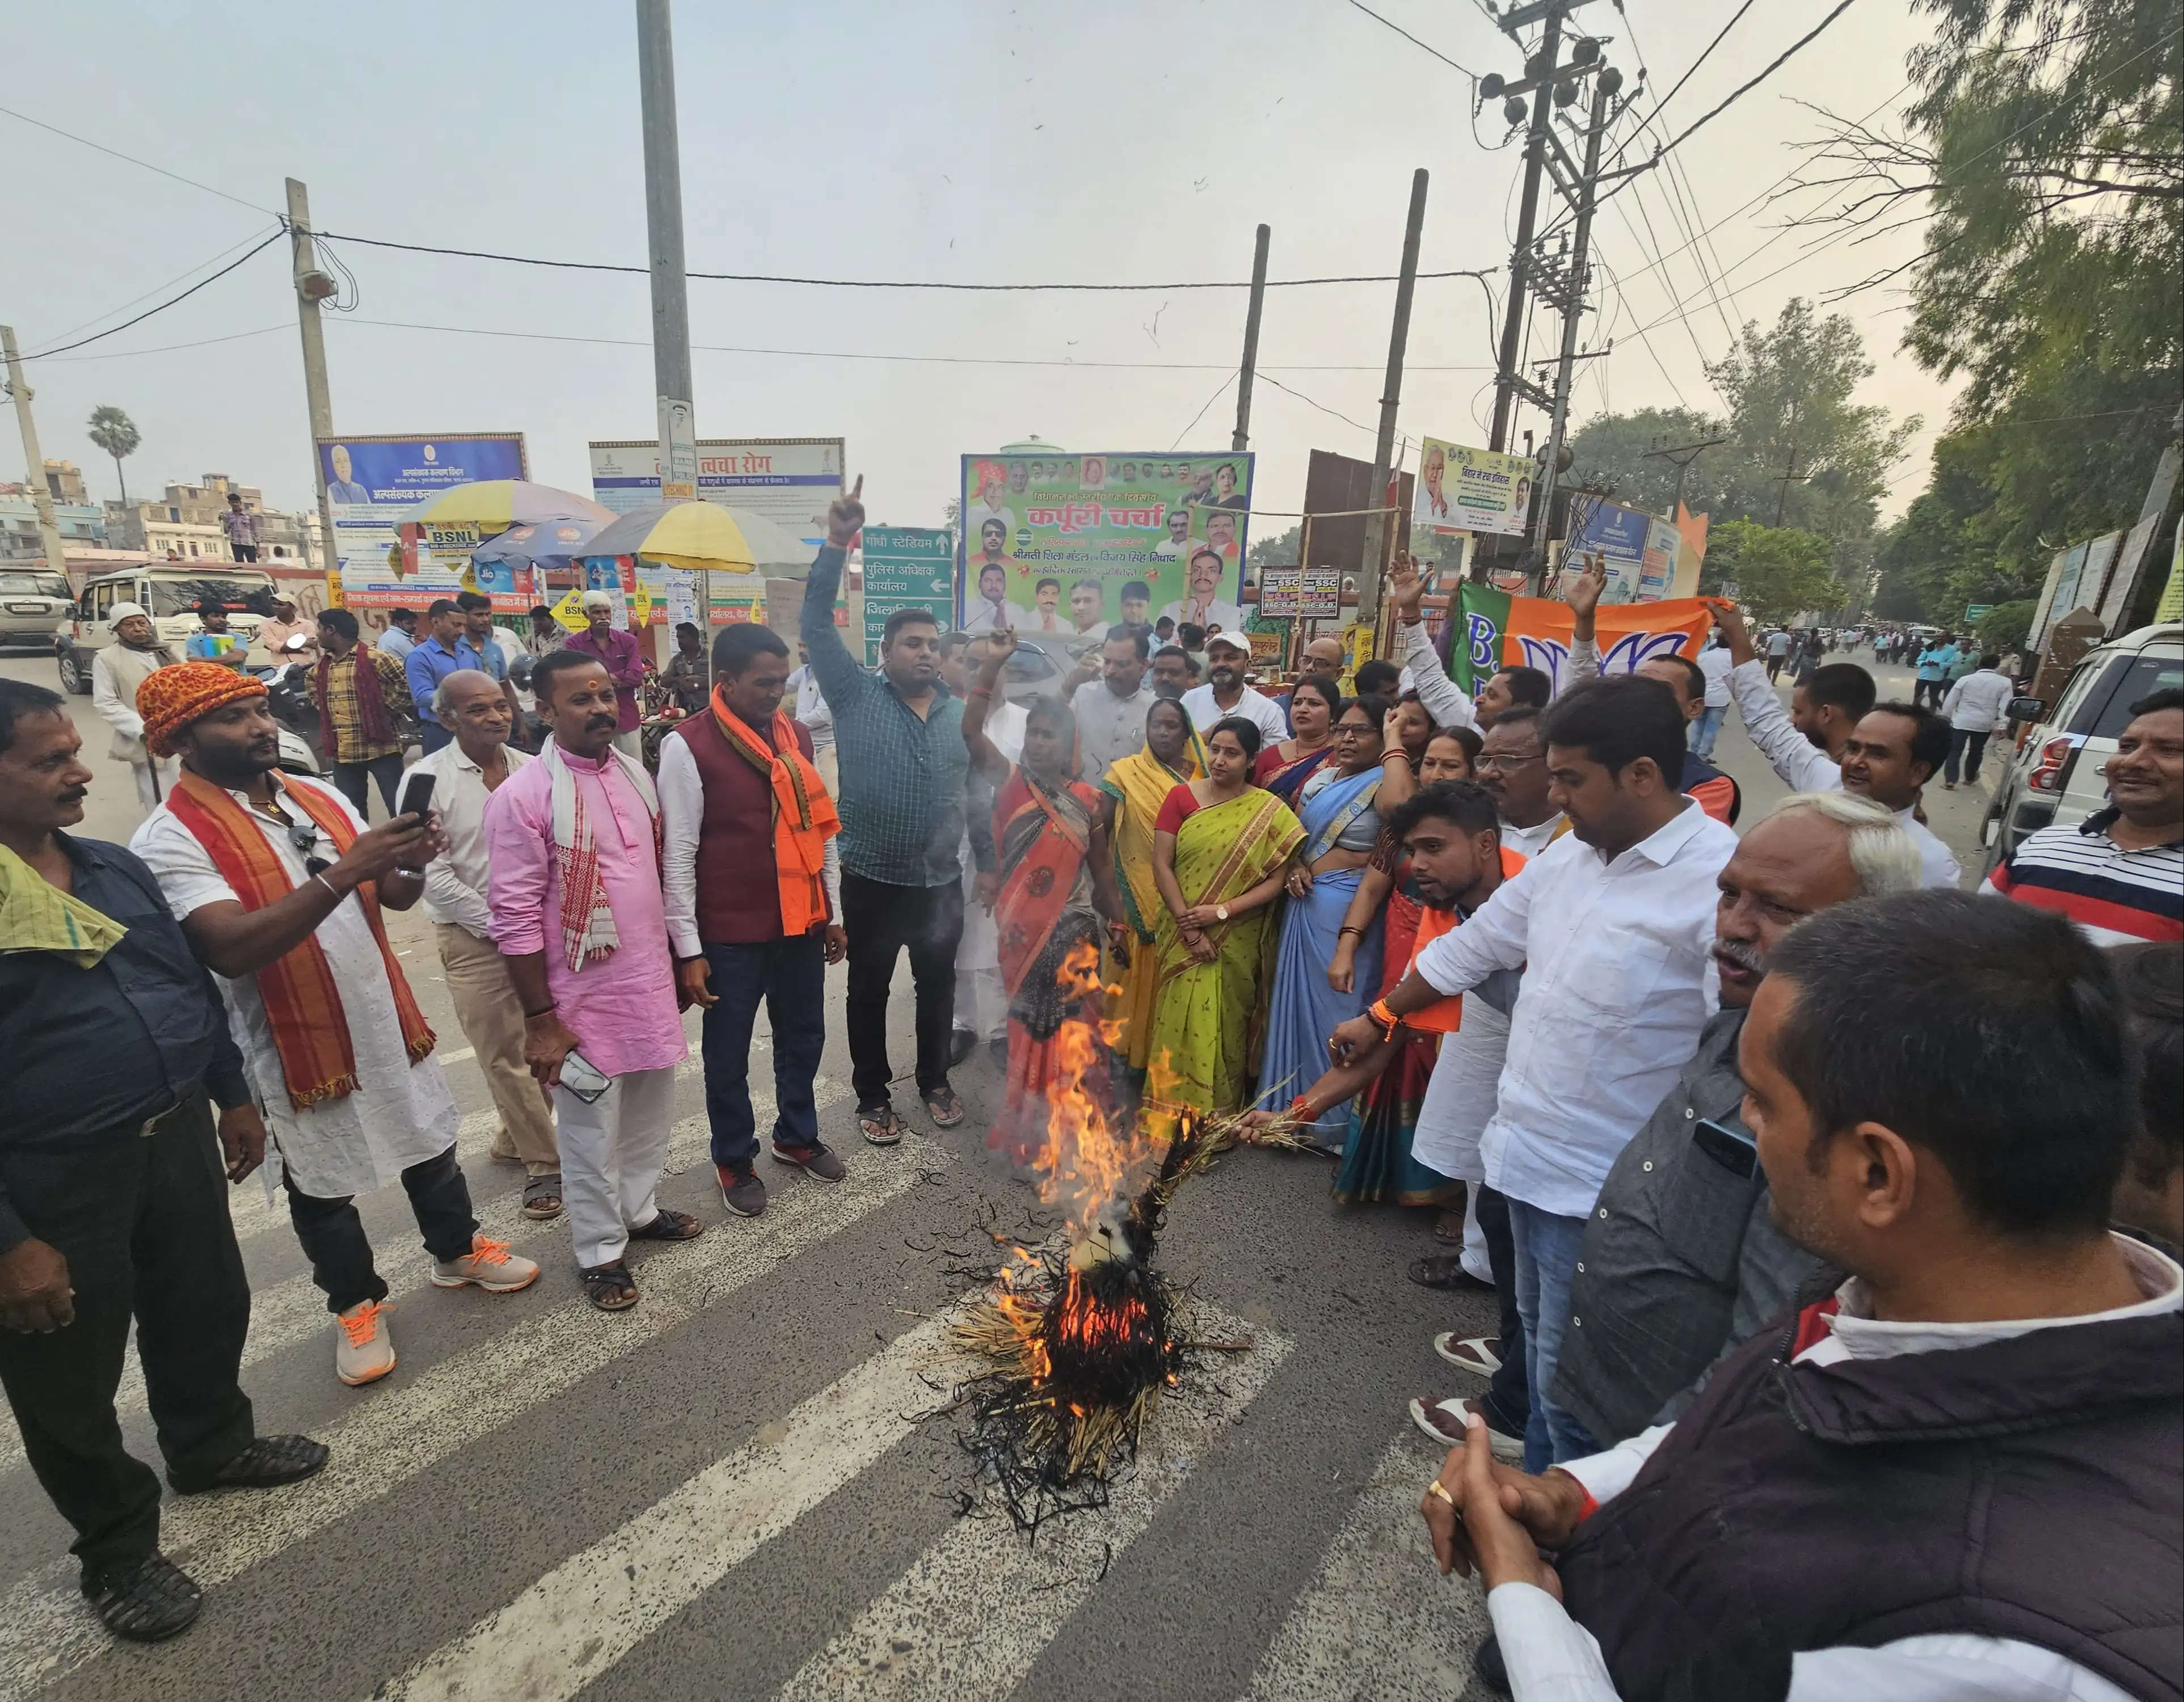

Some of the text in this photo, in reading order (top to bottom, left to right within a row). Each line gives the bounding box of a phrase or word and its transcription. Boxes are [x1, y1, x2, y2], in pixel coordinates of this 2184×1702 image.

[699, 452, 772, 474] त्वचा रोग
[1462, 465, 1476, 477] बिहार
[1492, 472, 1511, 485] इतिहास
[373, 487, 415, 500] अल्पसंख्यक
[1026, 503, 1166, 533] कर्पूरी चर्चा
[432, 531, 476, 543] BSNL
[892, 535, 932, 549] स्टेडियम
[1013, 548, 1040, 560] श्रीमती
[1043, 549, 1064, 561] शिला
[1129, 550, 1146, 563] सिंह
[866, 561, 895, 579] पुलिस
[866, 579, 907, 592] कार्यालय
[565, 606, 584, 615] BSN
